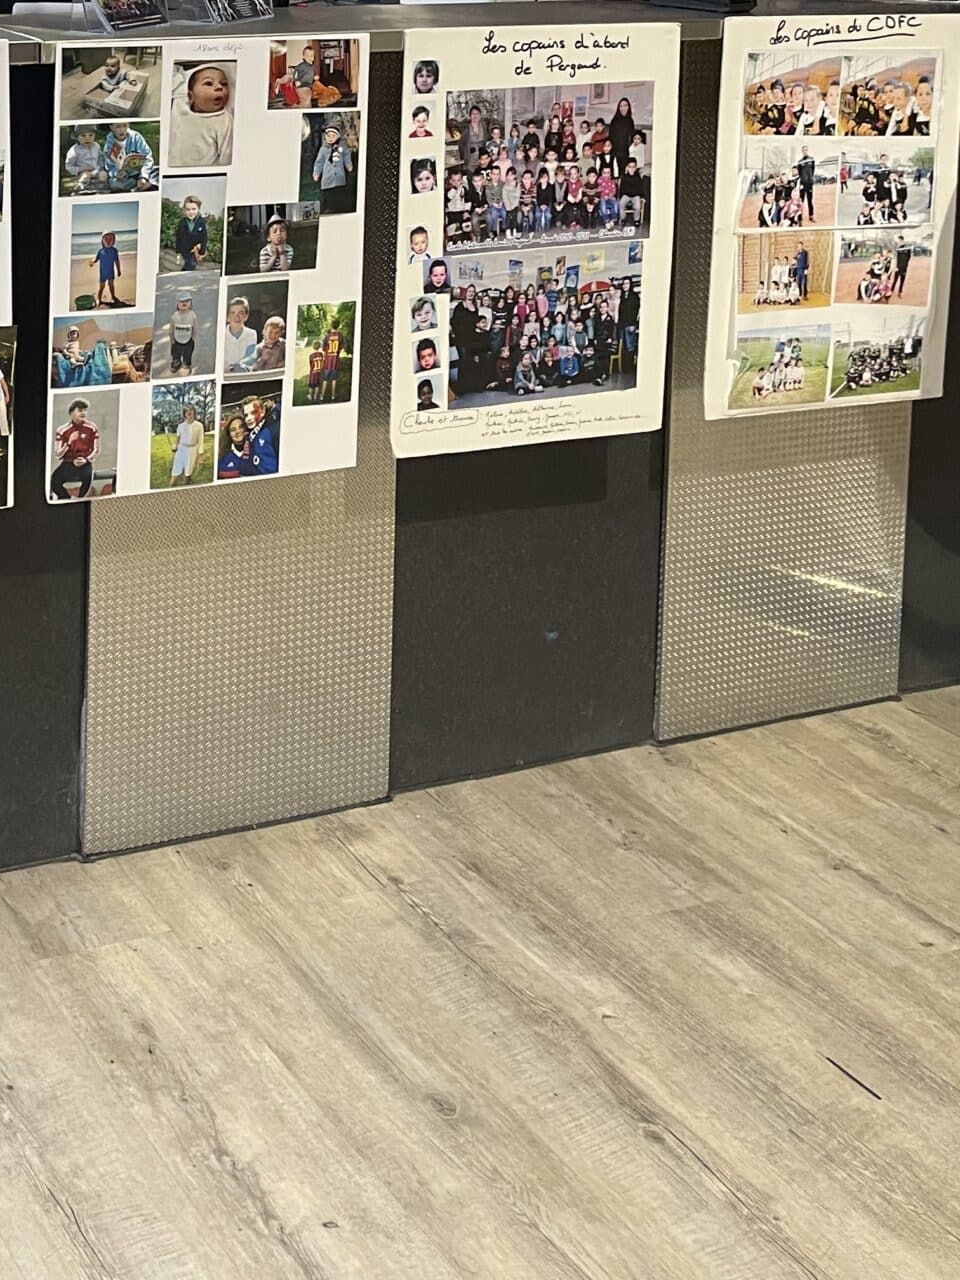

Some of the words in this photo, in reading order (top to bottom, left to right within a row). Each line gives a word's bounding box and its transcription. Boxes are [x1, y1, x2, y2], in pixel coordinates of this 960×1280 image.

[769, 19, 791, 46] Les
[793, 22, 841, 46] copains
[847, 18, 862, 33] du
[481, 30, 507, 54] Les
[512, 37, 566, 58] copains
[574, 32, 630, 51] d'abord
[515, 59, 533, 76] de
[327, 340, 339, 353] 10
